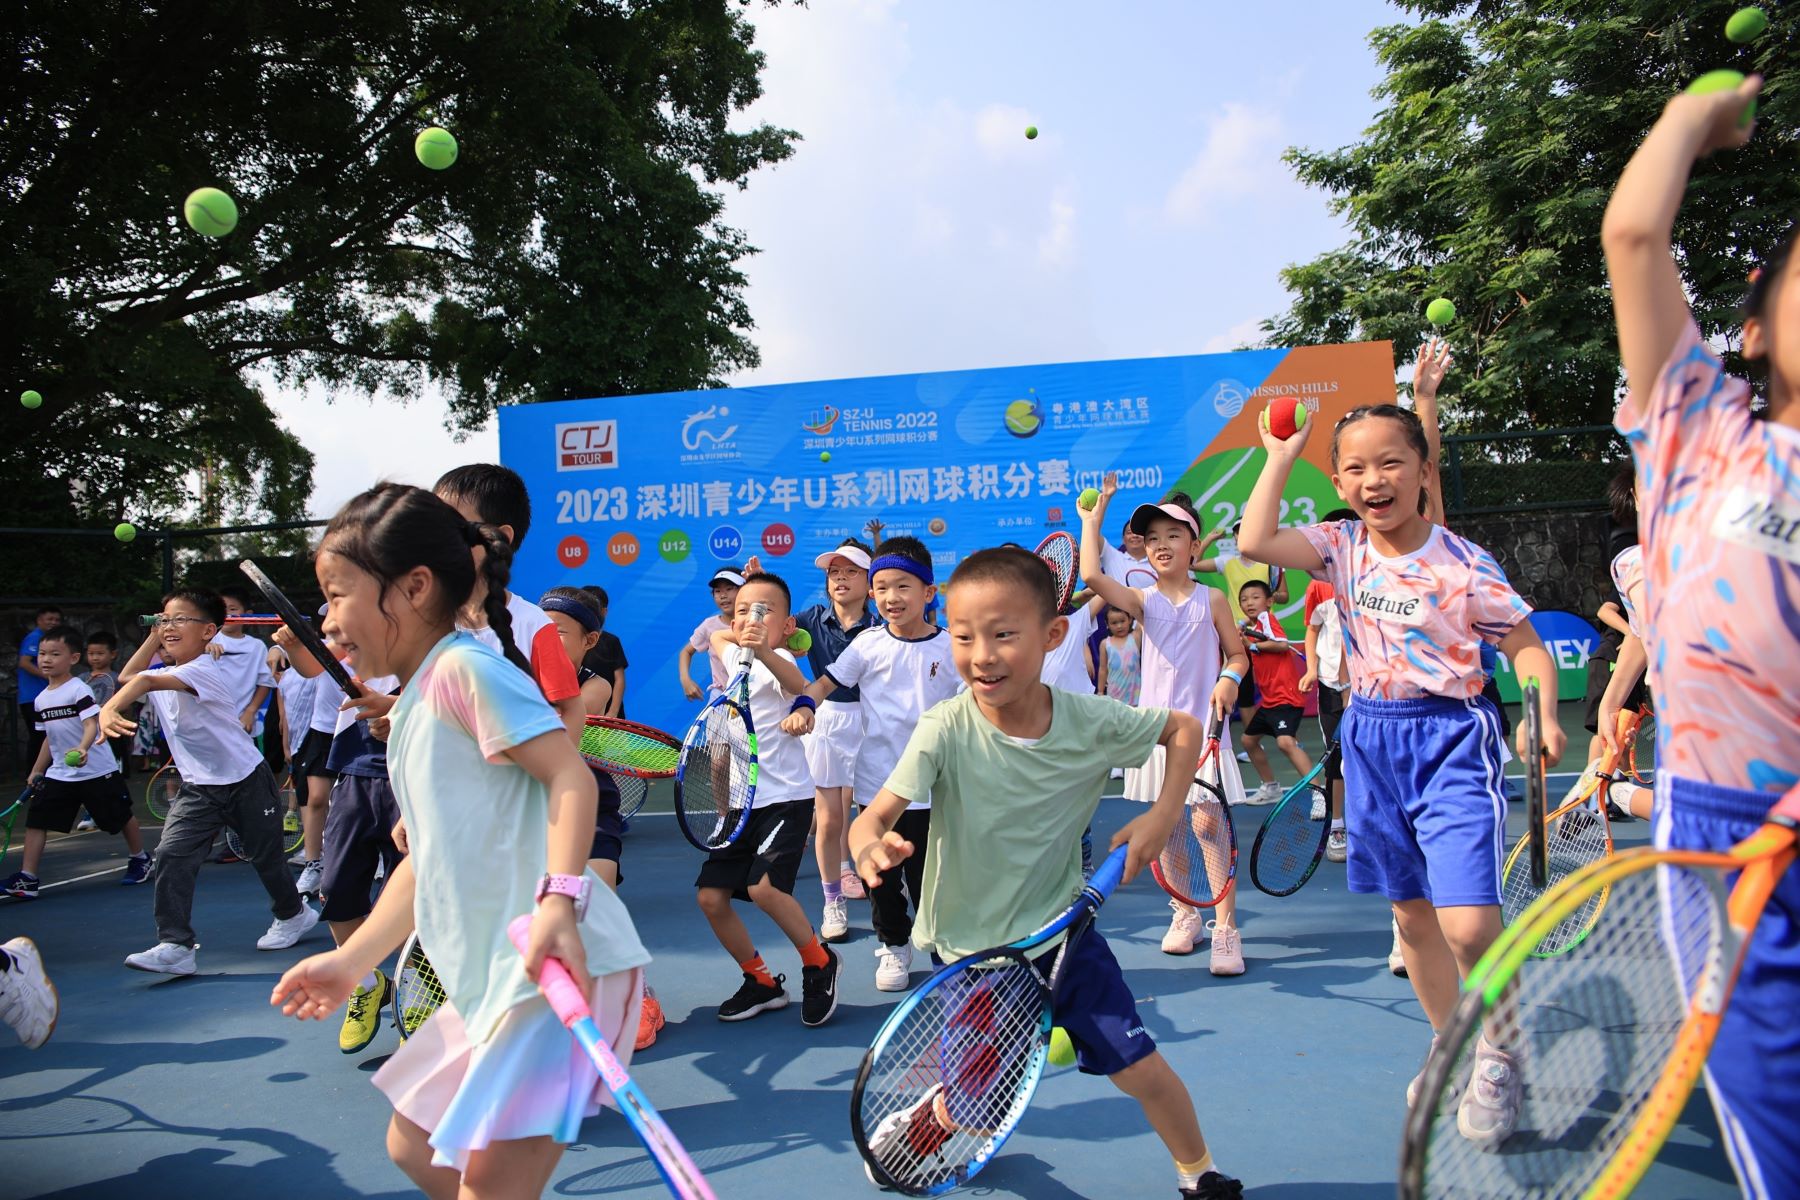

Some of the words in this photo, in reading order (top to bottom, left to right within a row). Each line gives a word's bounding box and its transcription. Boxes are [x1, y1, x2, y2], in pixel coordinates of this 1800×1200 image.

[1246, 384, 1299, 398] MISSION
[1302, 381, 1339, 394] HILLS
[843, 408, 874, 421] SZ-U
[895, 411, 938, 429] 2022
[843, 419, 893, 432] TENNIS
[561, 425, 612, 450] CTJ
[803, 430, 938, 450] 深圳青少年U系列网球积分赛
[572, 453, 602, 465] TOUR
[556, 486, 628, 524] 2023
[636, 458, 1071, 521] 深圳青少年U系列网球积分赛
[1074, 465, 1163, 493] (CTJC200)
[662, 540, 687, 553] U12
[713, 537, 740, 549] U14
[766, 534, 793, 546] U16
[564, 546, 582, 558] U8
[611, 543, 636, 556] U10
[1356, 590, 1420, 616] Nature
[1495, 638, 1592, 673] YEX
